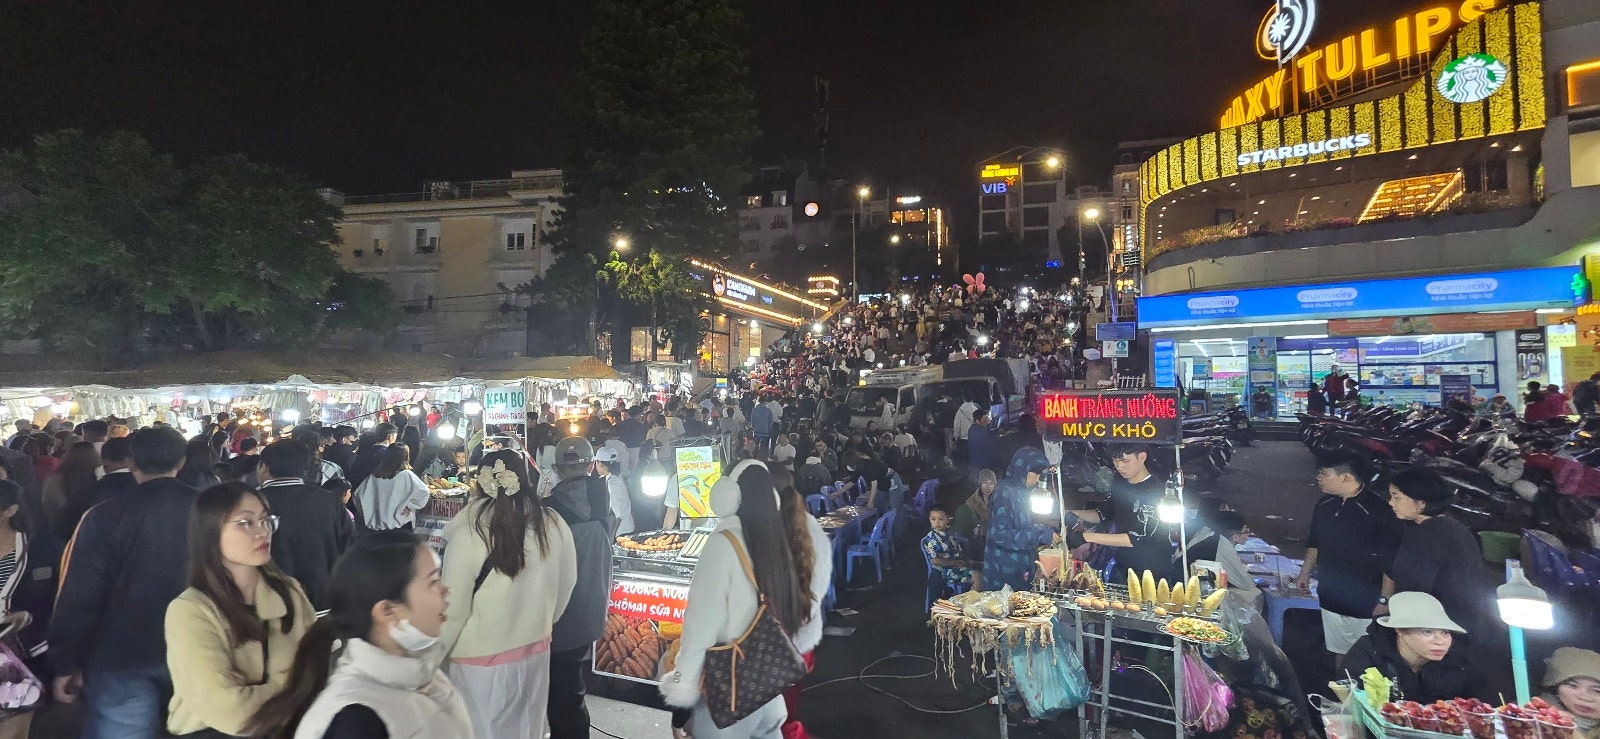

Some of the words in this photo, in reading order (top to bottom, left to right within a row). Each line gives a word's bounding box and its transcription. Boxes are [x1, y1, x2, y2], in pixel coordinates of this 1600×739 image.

[1297, 0, 1495, 93] TULIPS
[1237, 133, 1371, 166] STARBUCKS
[981, 182, 1007, 194] VIB
[1431, 281, 1493, 292] Pharmacity
[1190, 298, 1236, 307] Pharmacity
[1301, 290, 1353, 300] Pharmacity
[1044, 393, 1078, 418] BÁNH
[1080, 394, 1123, 418] TRÁNG
[1127, 392, 1177, 418] NƯỚNG
[1062, 421, 1106, 439] MỰC
[1112, 420, 1156, 438] KHÔ
[607, 598, 648, 614] PHÔMAI
